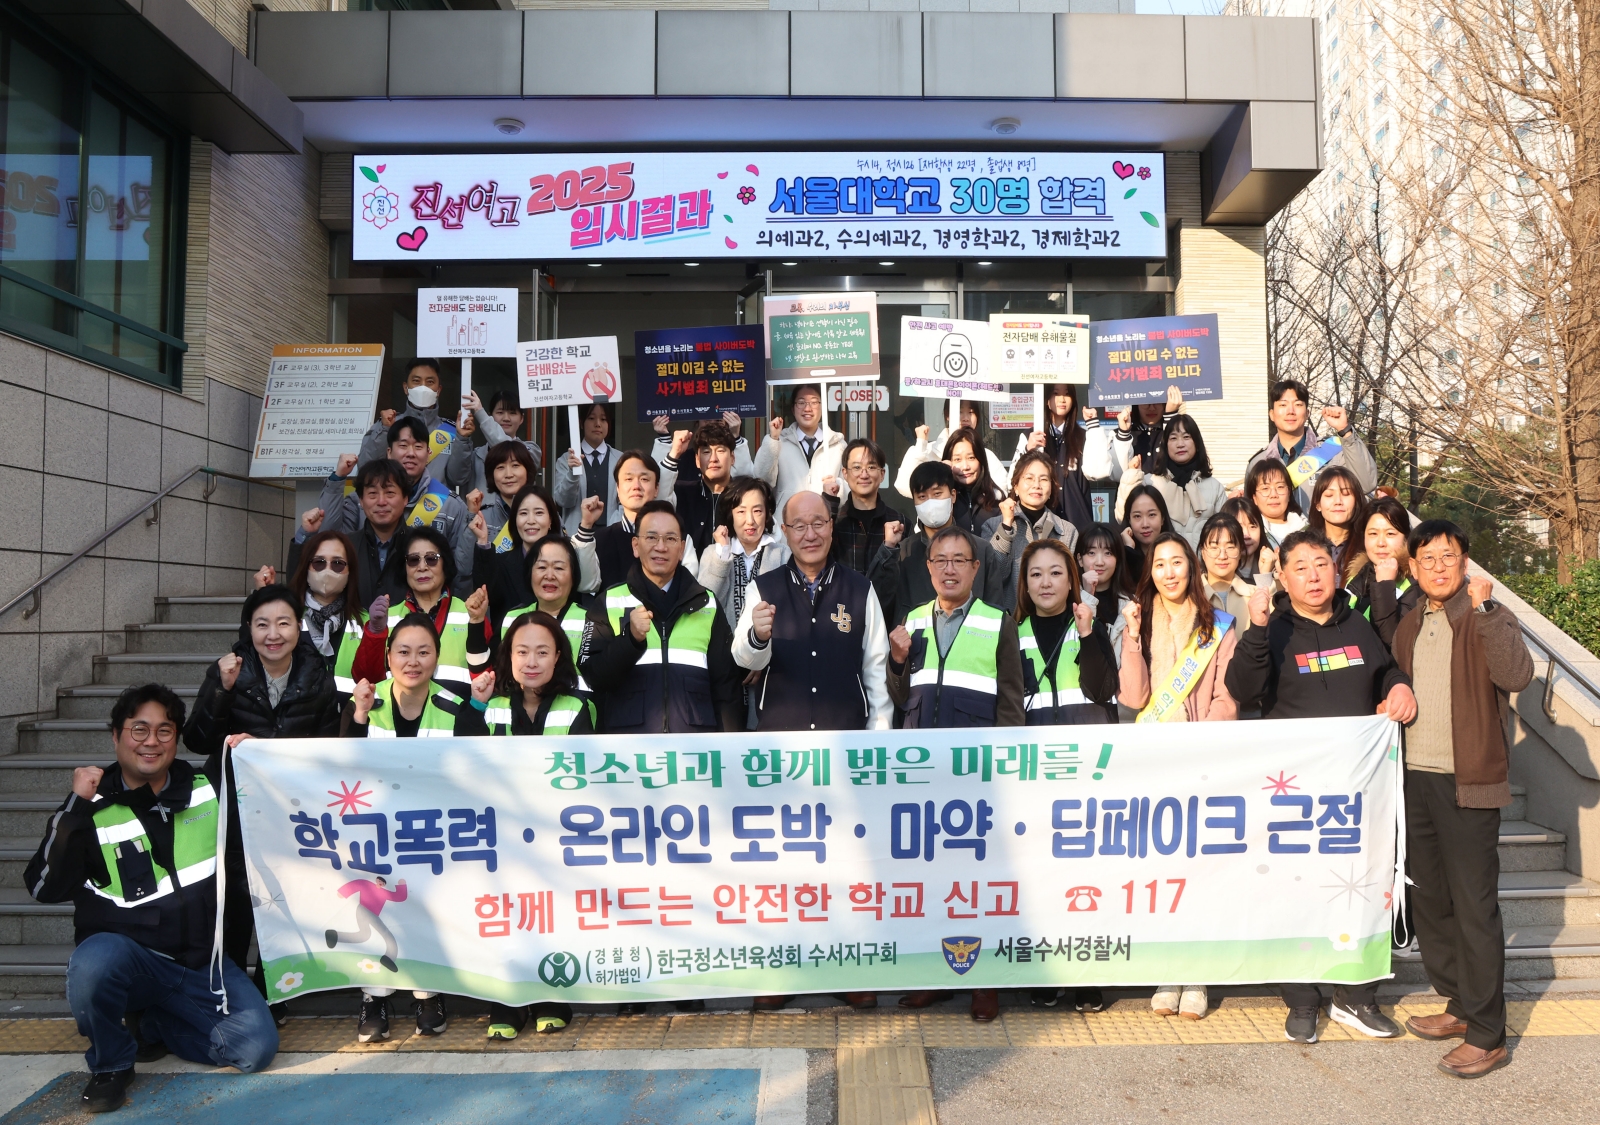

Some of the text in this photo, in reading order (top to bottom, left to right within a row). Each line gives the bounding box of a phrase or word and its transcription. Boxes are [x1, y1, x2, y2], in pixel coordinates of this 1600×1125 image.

[987, 157, 1013, 174] 졸업생
[527, 161, 635, 216] 2025
[768, 176, 1106, 215] 서울대학교 30명 합격
[411, 181, 522, 231] 진선여고
[570, 189, 713, 250] 입시결과
[756, 228, 1121, 250] 의예과2, 수의예과2, 경영학과2, 경제학과2
[428, 303, 507, 313] 전자담배도 담배입니다
[908, 320, 954, 332] 안전 사고 예방
[1003, 331, 1077, 344] 전자담배 유해물질
[1096, 334, 1124, 344] 청소년을
[1125, 333, 1146, 342] 노리는
[1167, 327, 1210, 339] 사이버도박
[525, 345, 591, 362] 건강한 학교
[644, 345, 672, 354] 청소년을
[673, 344, 694, 353] 노리는
[714, 340, 755, 351] 사이버도박
[1107, 346, 1199, 364] 절대 이길 수 없는
[526, 361, 577, 377] 담배없는
[656, 360, 745, 377] 절대 이길 수 없는
[1107, 364, 1201, 383] 사기범죄 입니다
[527, 378, 553, 392] 학교
[656, 379, 747, 397] 사기범죄 입니다
[542, 749, 726, 790] 청소년과
[741, 747, 831, 788] 함께
[846, 745, 936, 786] 밝은
[289, 805, 498, 876] 학교폭력
[558, 803, 712, 868] 온라인
[730, 802, 832, 865] 도박
[890, 799, 993, 862] 마약
[1050, 795, 1247, 860] 딥페이크
[1266, 791, 1364, 855] 근절
[474, 878, 1187, 939] 함께 만드는 안전한 학교 신고 117
[656, 941, 897, 975] 한국청소년육성회 수서지구회
[994, 935, 1132, 963] 서울수서경찰서
